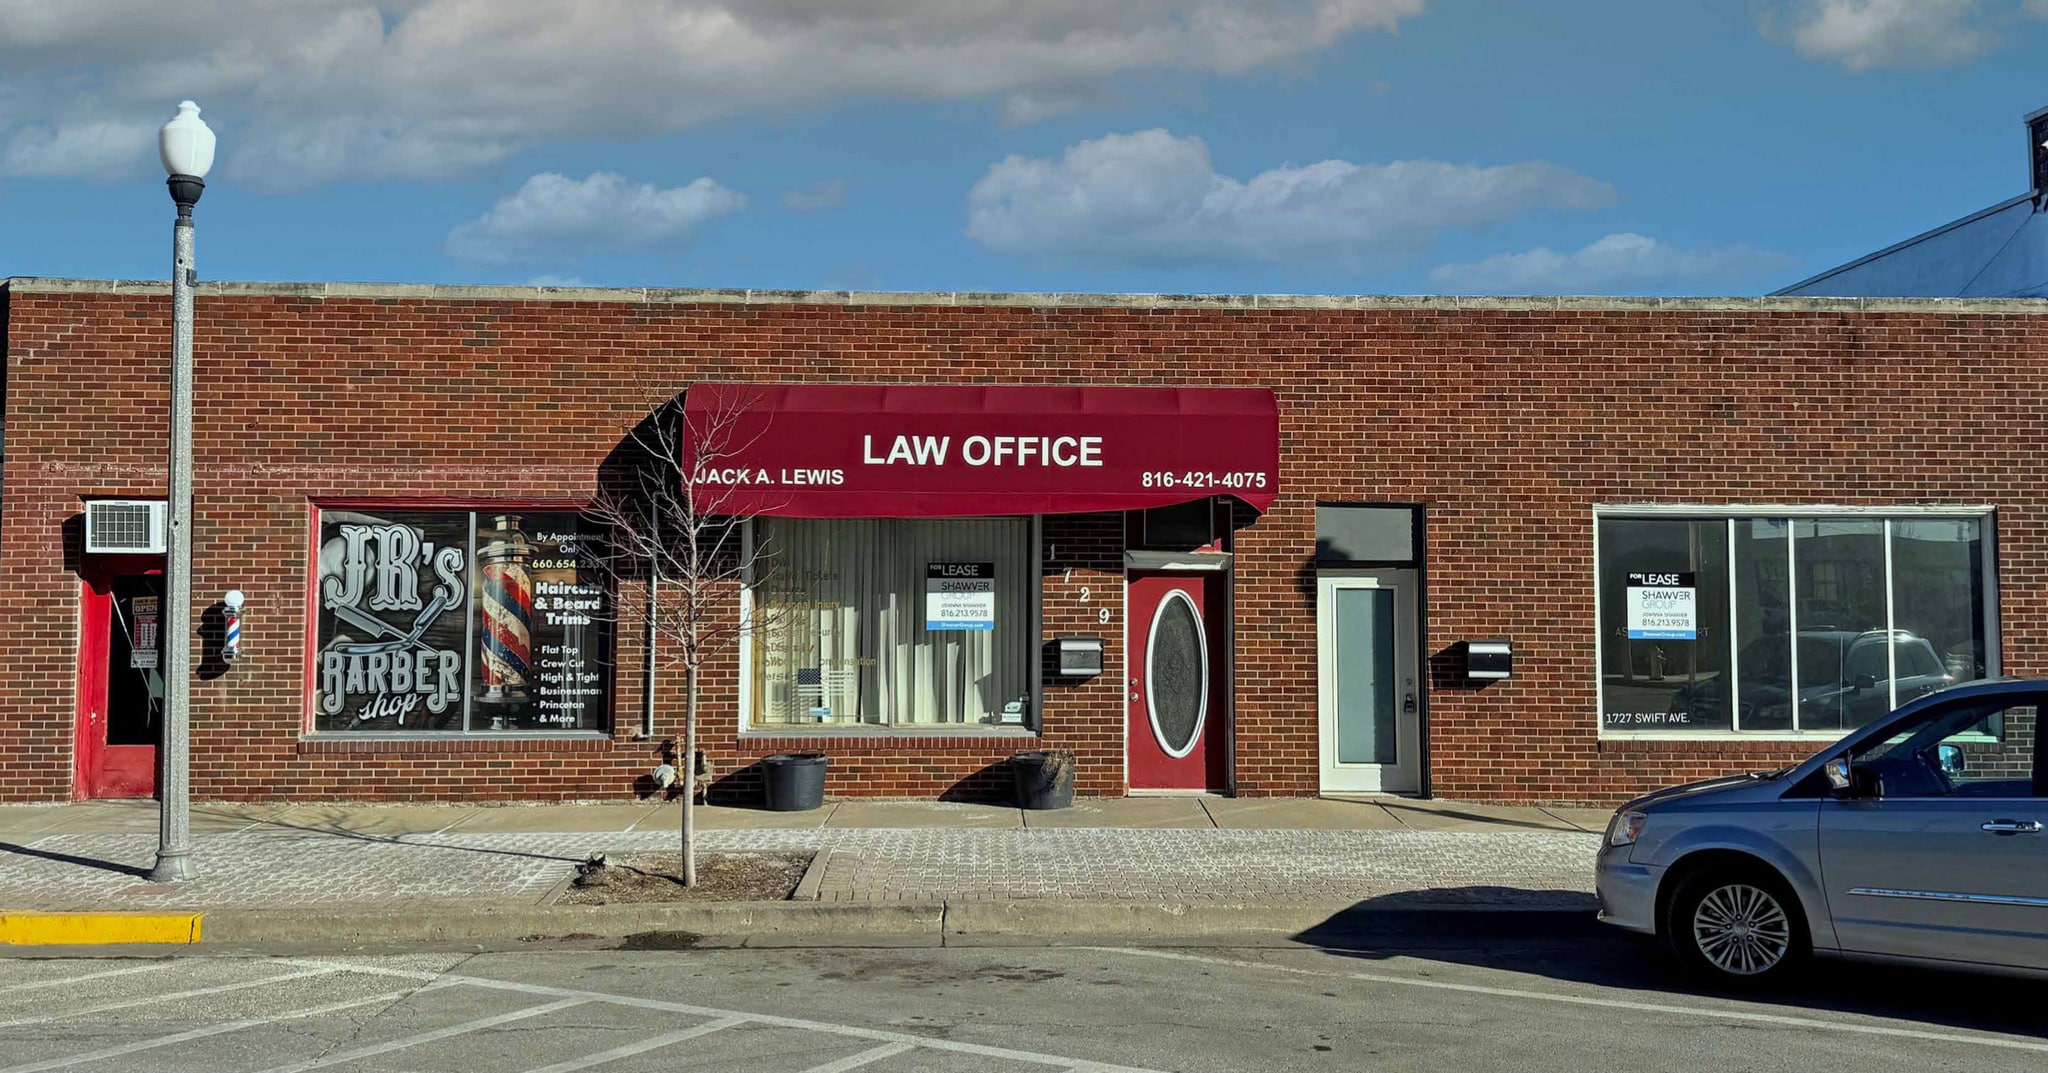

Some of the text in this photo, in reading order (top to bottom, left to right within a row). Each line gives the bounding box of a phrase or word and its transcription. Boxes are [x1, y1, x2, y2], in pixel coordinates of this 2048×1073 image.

[863, 434, 1103, 467] LAW OFFICE
[695, 468, 844, 485] JACK A. LEWIS
[1142, 471, 1266, 488] 816-421-4075
[537, 532, 604, 543] By Appointment
[560, 544, 580, 555] Only
[324, 524, 465, 610] JR's
[942, 565, 979, 576] LEASE
[1642, 574, 1679, 585] LEASE
[941, 581, 990, 591] SHAWVER
[1642, 590, 1691, 600] SHAWVER
[534, 597, 601, 610] & Beard
[1642, 600, 1677, 609] GROUP
[546, 612, 591, 625] Trims
[941, 609, 988, 618] 816.213.9578
[1642, 619, 1690, 627] 816.213.9578
[541, 645, 578, 656] Flat Top
[541, 660, 585, 668] Crew Cut
[322, 650, 461, 714] BARBER
[540, 673, 599, 683] High & Tight
[540, 686, 602, 695] Businessman
[359, 690, 423, 725] shop
[540, 700, 585, 709] Princeton
[539, 714, 575, 723] & More
[1606, 713, 1690, 723] 1727 SWIFT AVE.
